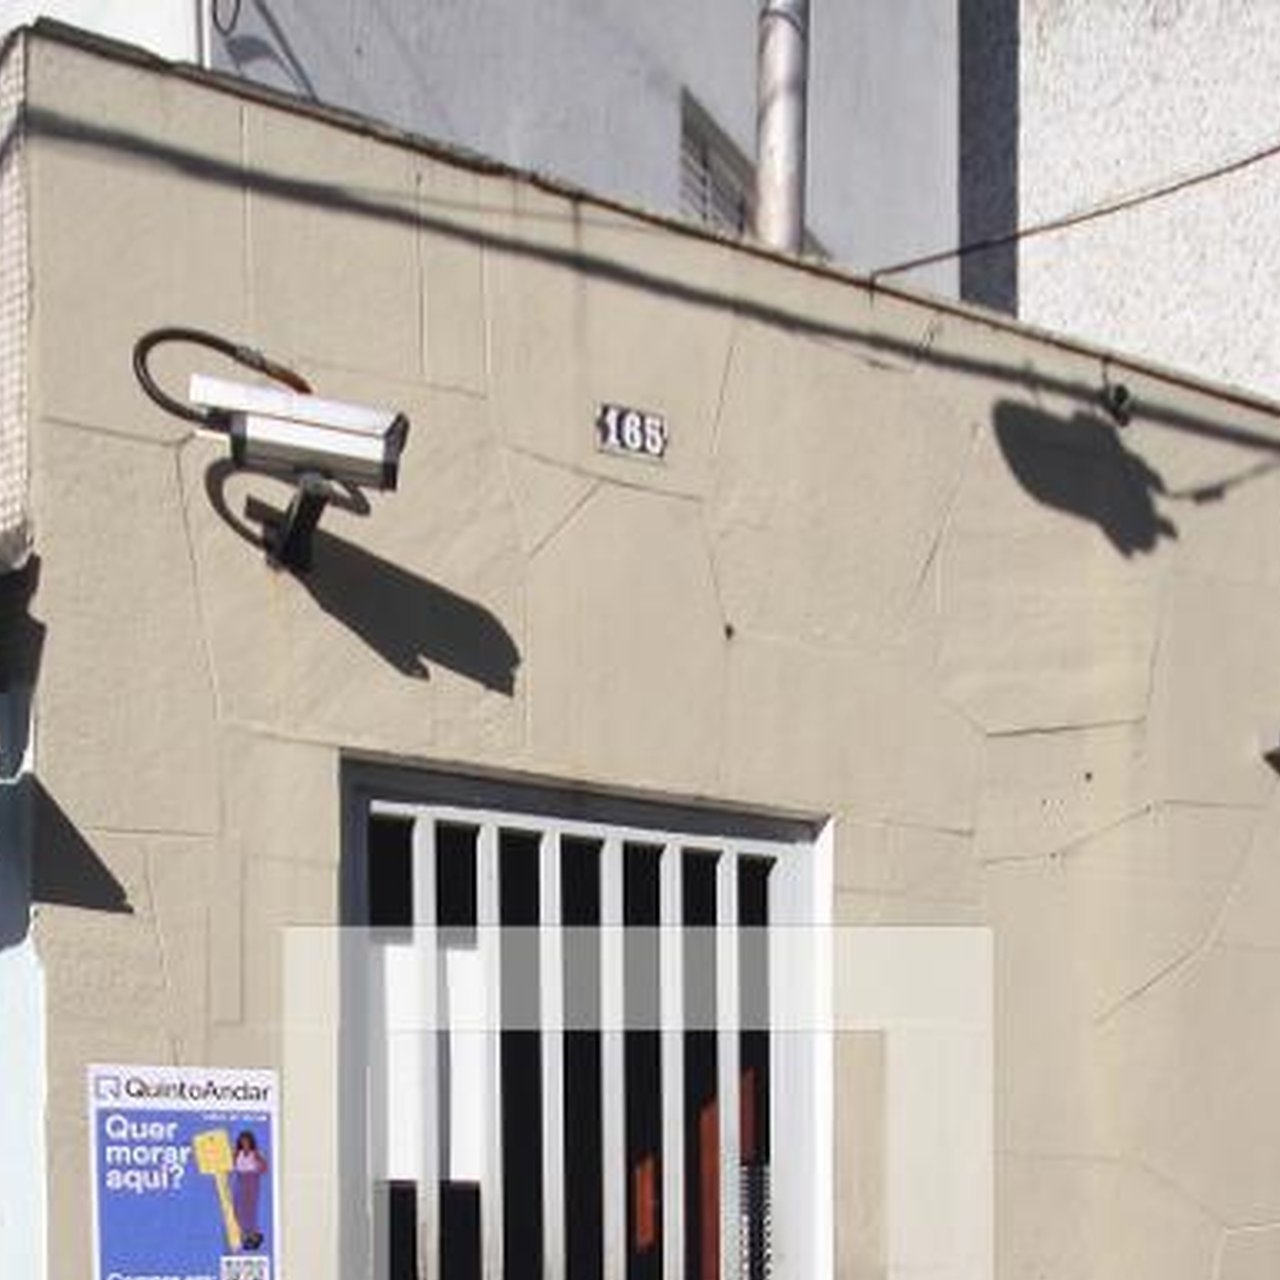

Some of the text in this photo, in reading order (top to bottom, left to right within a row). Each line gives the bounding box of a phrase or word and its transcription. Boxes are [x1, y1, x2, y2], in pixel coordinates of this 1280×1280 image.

[605, 409, 664, 455] 165
[125, 1078, 269, 1101] QuintoAndar
[104, 1114, 178, 1141] Quer
[106, 1144, 191, 1165] morar
[106, 1165, 184, 1194] aqui?
